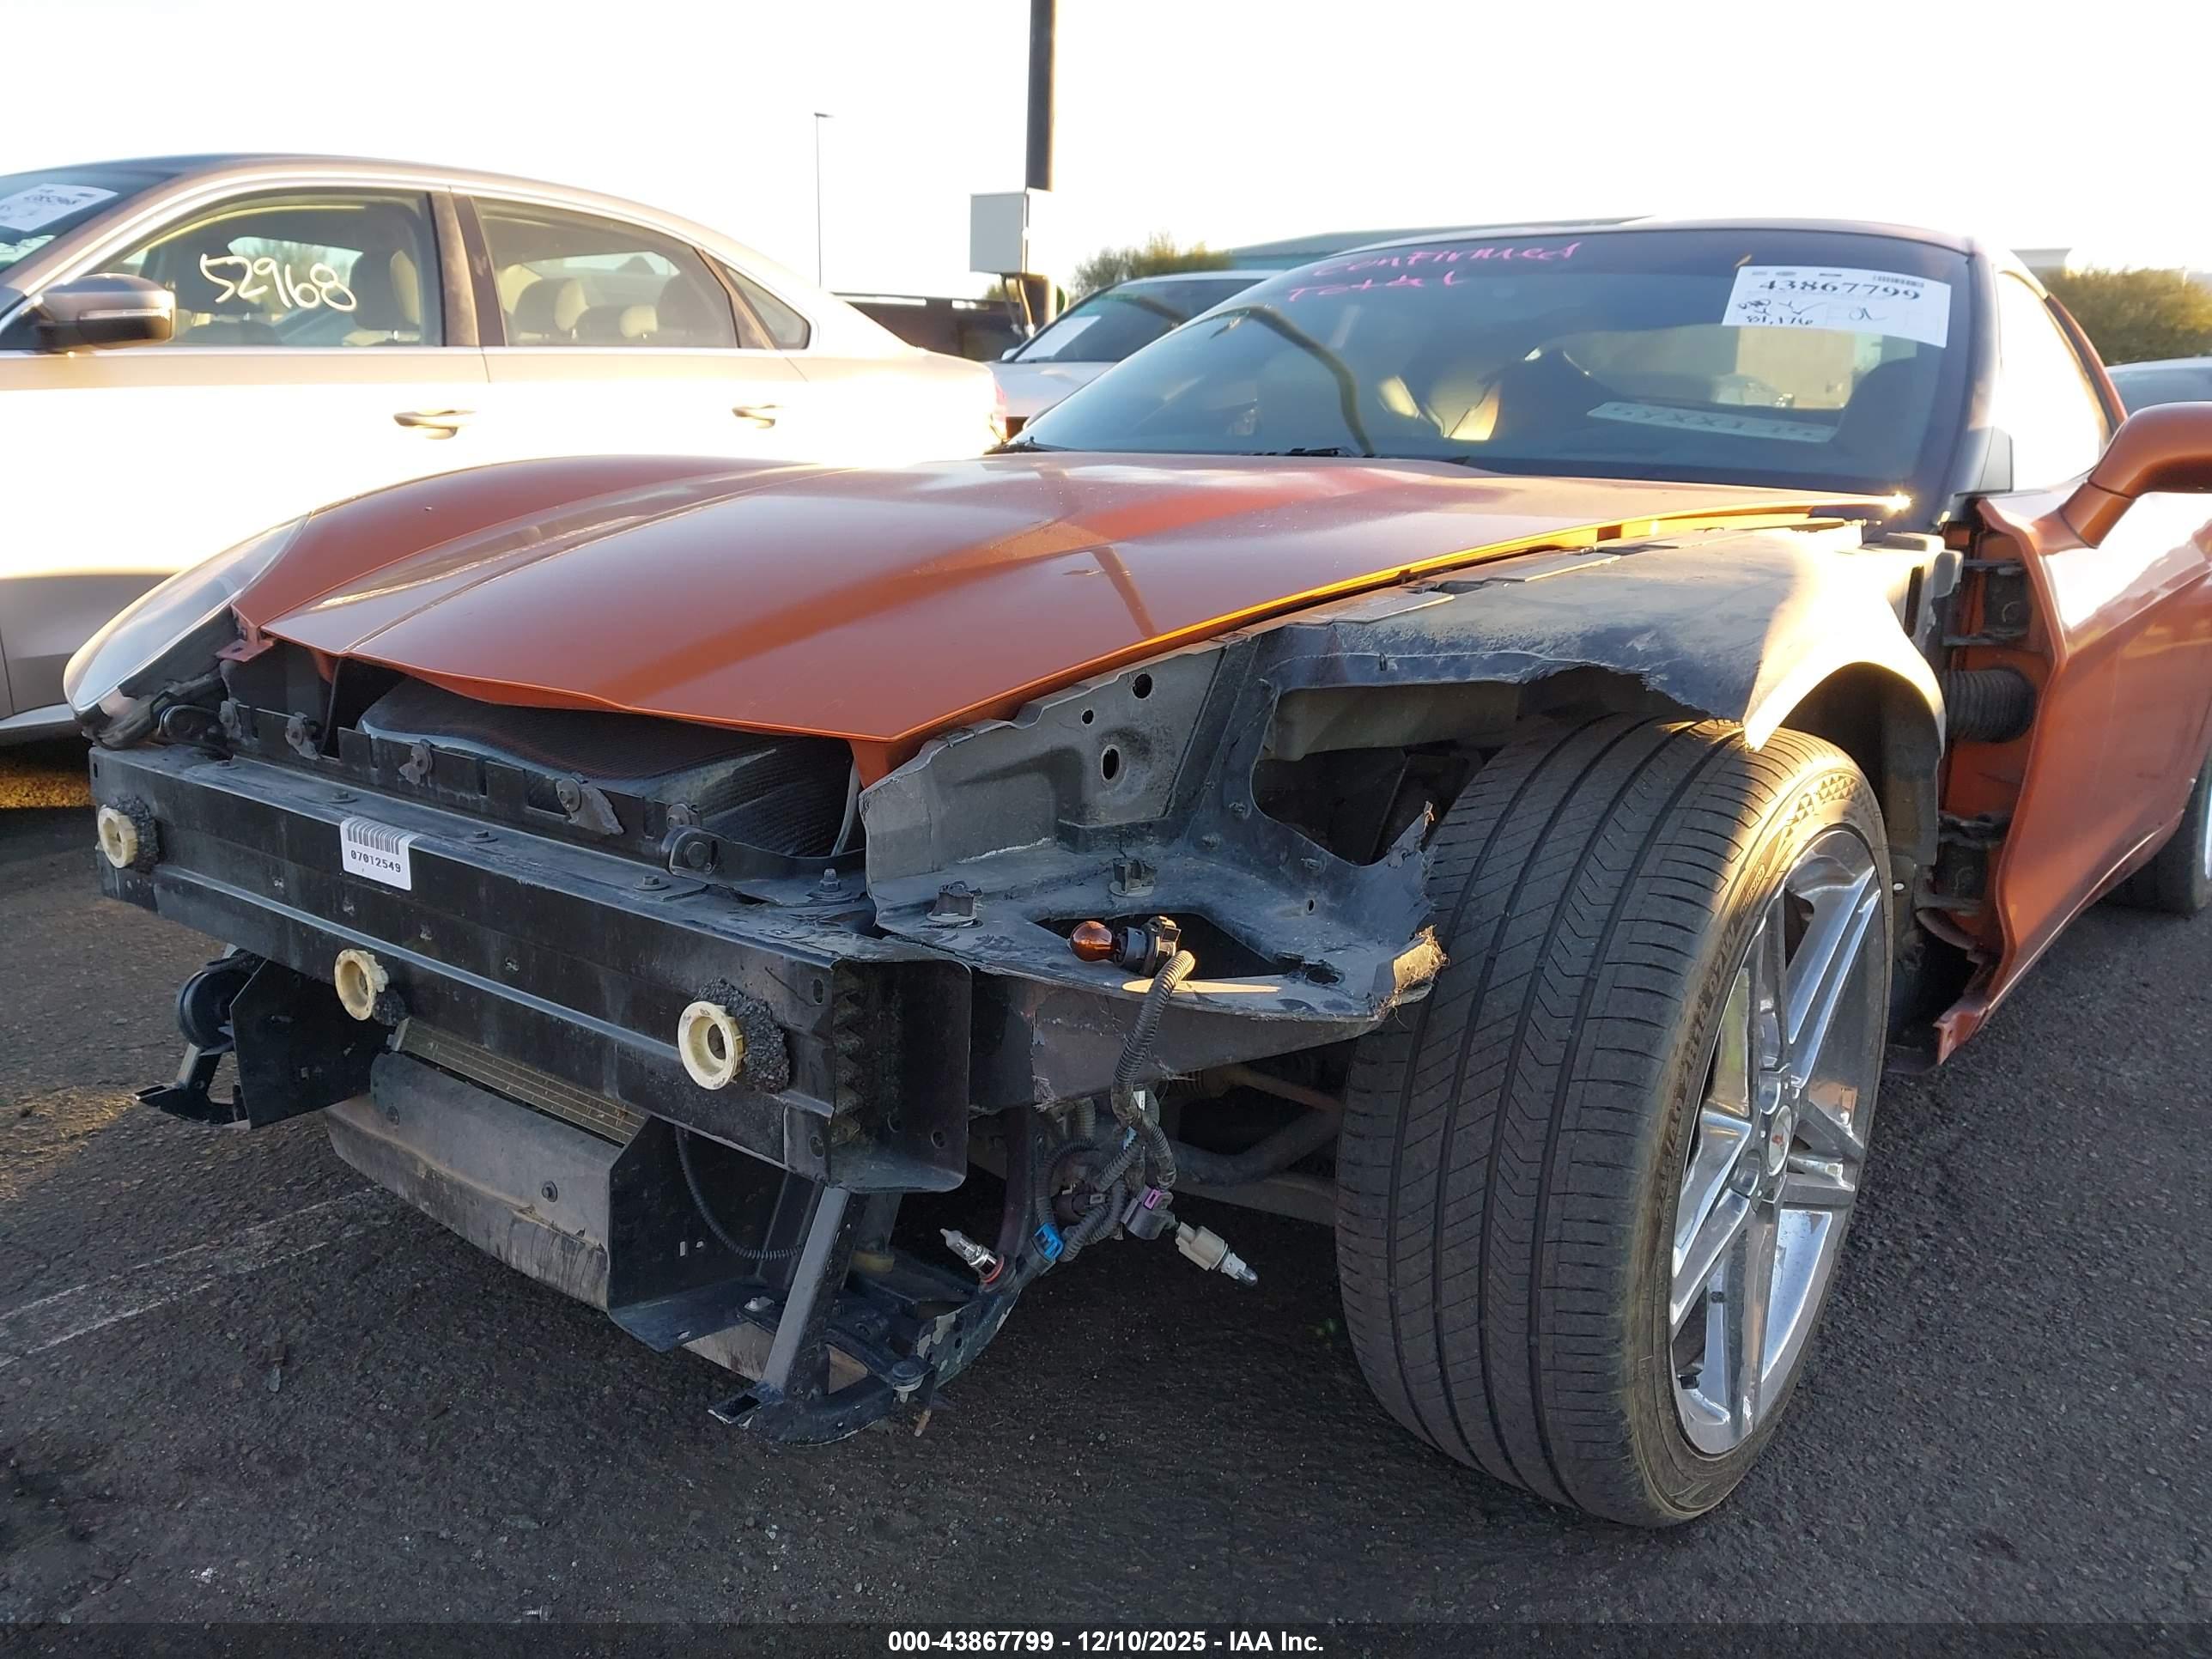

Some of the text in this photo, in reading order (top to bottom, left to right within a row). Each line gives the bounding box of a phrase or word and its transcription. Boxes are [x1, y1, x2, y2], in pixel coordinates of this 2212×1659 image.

[199, 252, 358, 312] 52968
[1759, 280, 1920, 300] 43867799
[350, 849, 402, 873] 07012549
